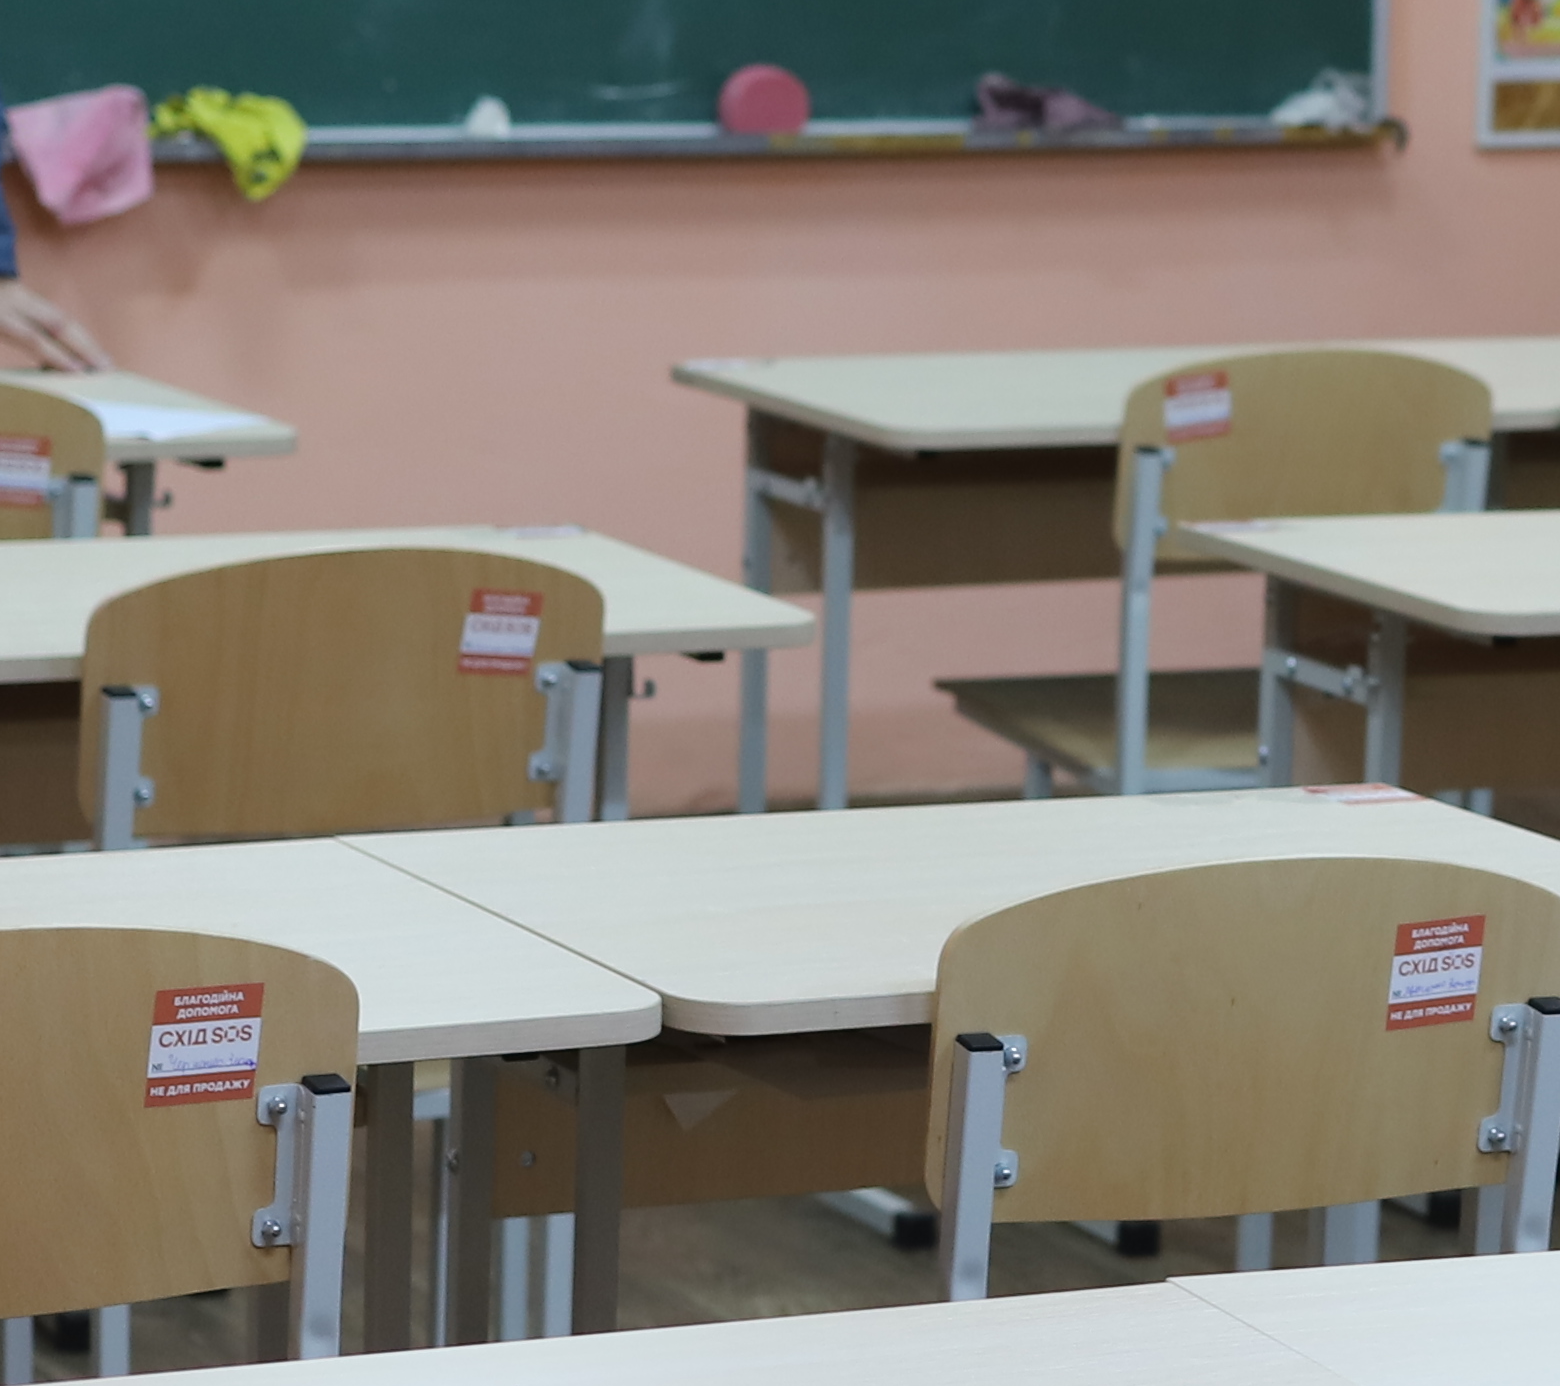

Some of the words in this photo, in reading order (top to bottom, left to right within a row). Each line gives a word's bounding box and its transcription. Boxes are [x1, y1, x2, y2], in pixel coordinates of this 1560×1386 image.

[1412, 923, 1469, 939] БЛАГОДІЙНА
[1414, 935, 1465, 950] ДОПОМОГА
[1399, 958, 1439, 977] СХІД
[1442, 954, 1475, 972] SOS
[174, 991, 245, 1007] БЛАГОДІЙНА
[177, 1005, 240, 1020] ДОПОМОГА
[1391, 1012, 1403, 1021] НЕ
[1404, 1010, 1424, 1021] ДЛЯ
[1425, 1003, 1473, 1016] ПРОДАЖУ
[159, 1029, 208, 1048] СХІД
[212, 1025, 253, 1044] SOS
[150, 1087, 165, 1097] НЕ
[167, 1084, 191, 1097] ДЛЯ
[193, 1080, 251, 1093] ПРОДАЖУ
